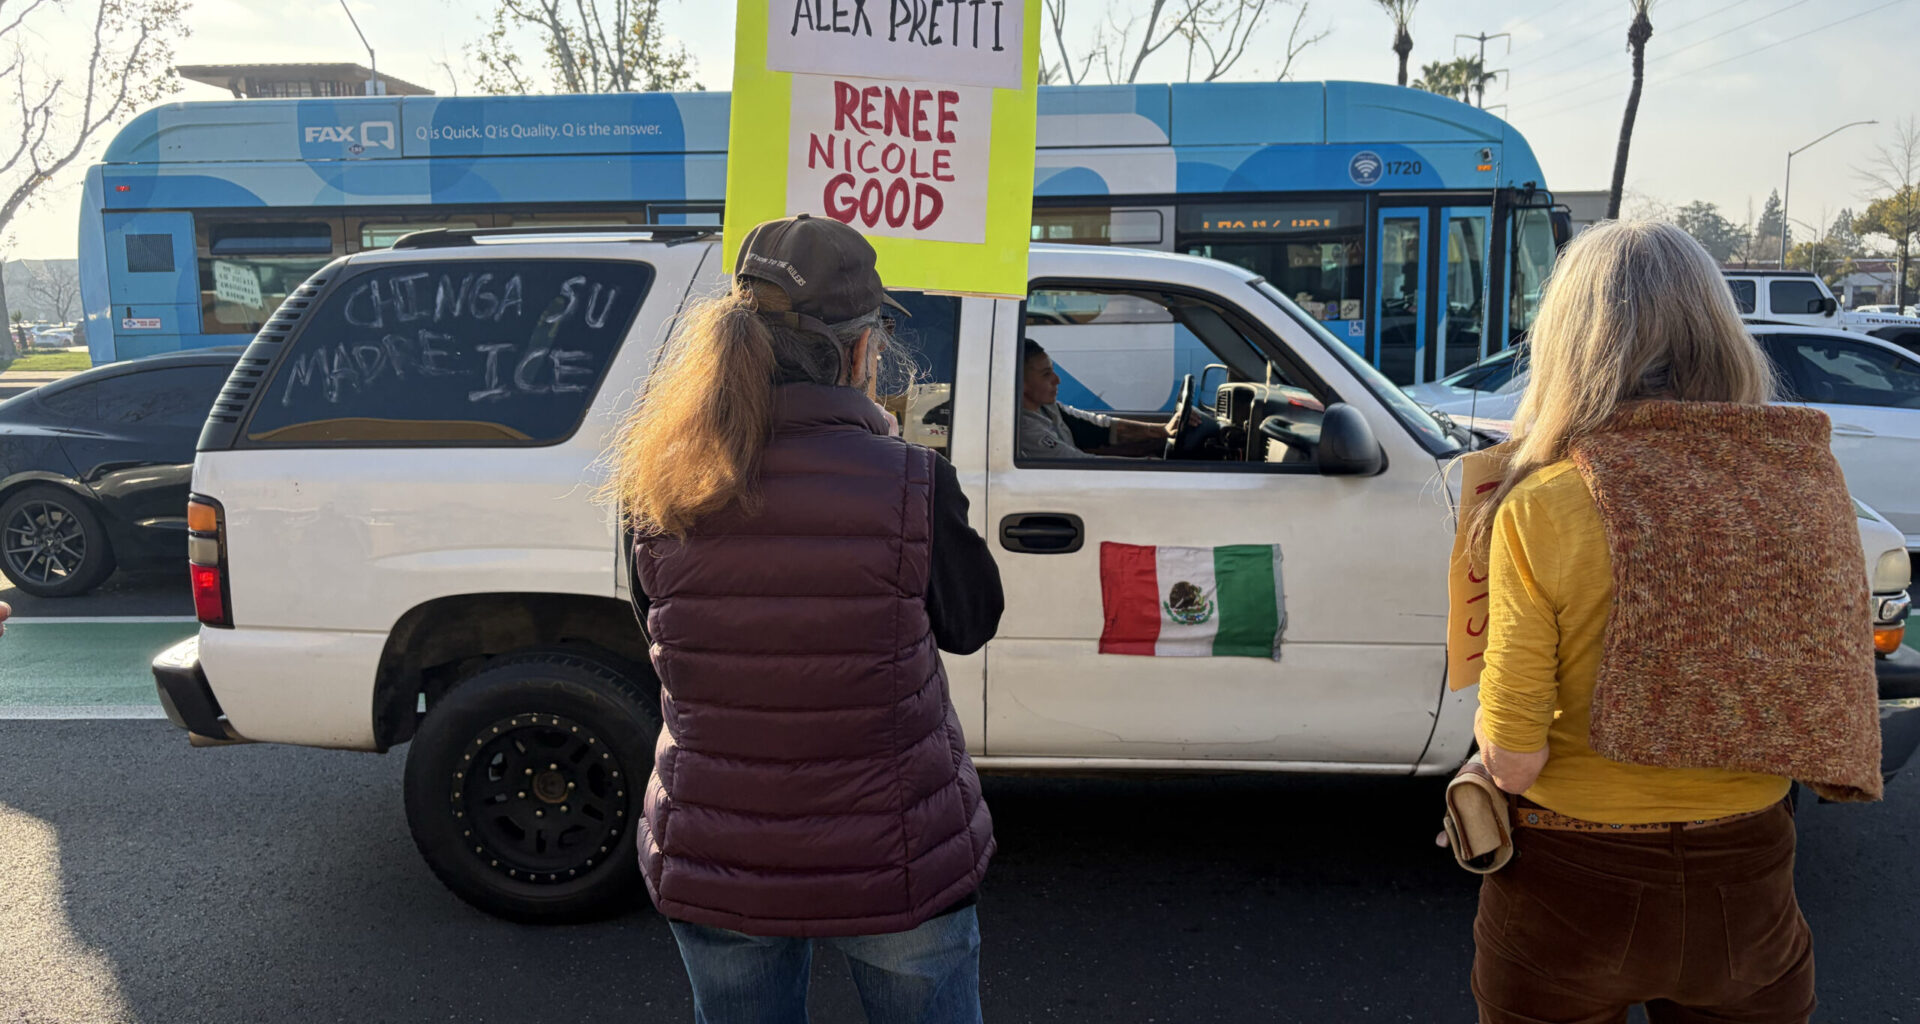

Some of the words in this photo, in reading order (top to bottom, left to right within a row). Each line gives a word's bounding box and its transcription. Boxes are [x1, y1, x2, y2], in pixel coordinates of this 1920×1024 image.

[791, 0, 872, 37] ALEX
[888, 0, 1005, 51] PRETTI
[304, 126, 355, 143] FAX
[415, 126, 428, 140] Q
[430, 125, 440, 139] is
[442, 125, 483, 140] Quick.
[484, 124, 497, 139] Q
[499, 125, 509, 138] is
[511, 123, 561, 140] Quality.
[562, 123, 574, 137] Q
[576, 123, 587, 136] is
[588, 122, 611, 136] the
[613, 122, 663, 136] answer.
[834, 80, 960, 143] RENEE
[808, 132, 956, 182] NICOLE
[1385, 161, 1423, 176] 1720
[823, 172, 944, 231] GOOD
[344, 272, 524, 329] CHINGA
[545, 275, 616, 329] SU
[787, 264, 806, 287] RULERS
[282, 328, 474, 406] MADRE
[468, 342, 594, 401] ICE
